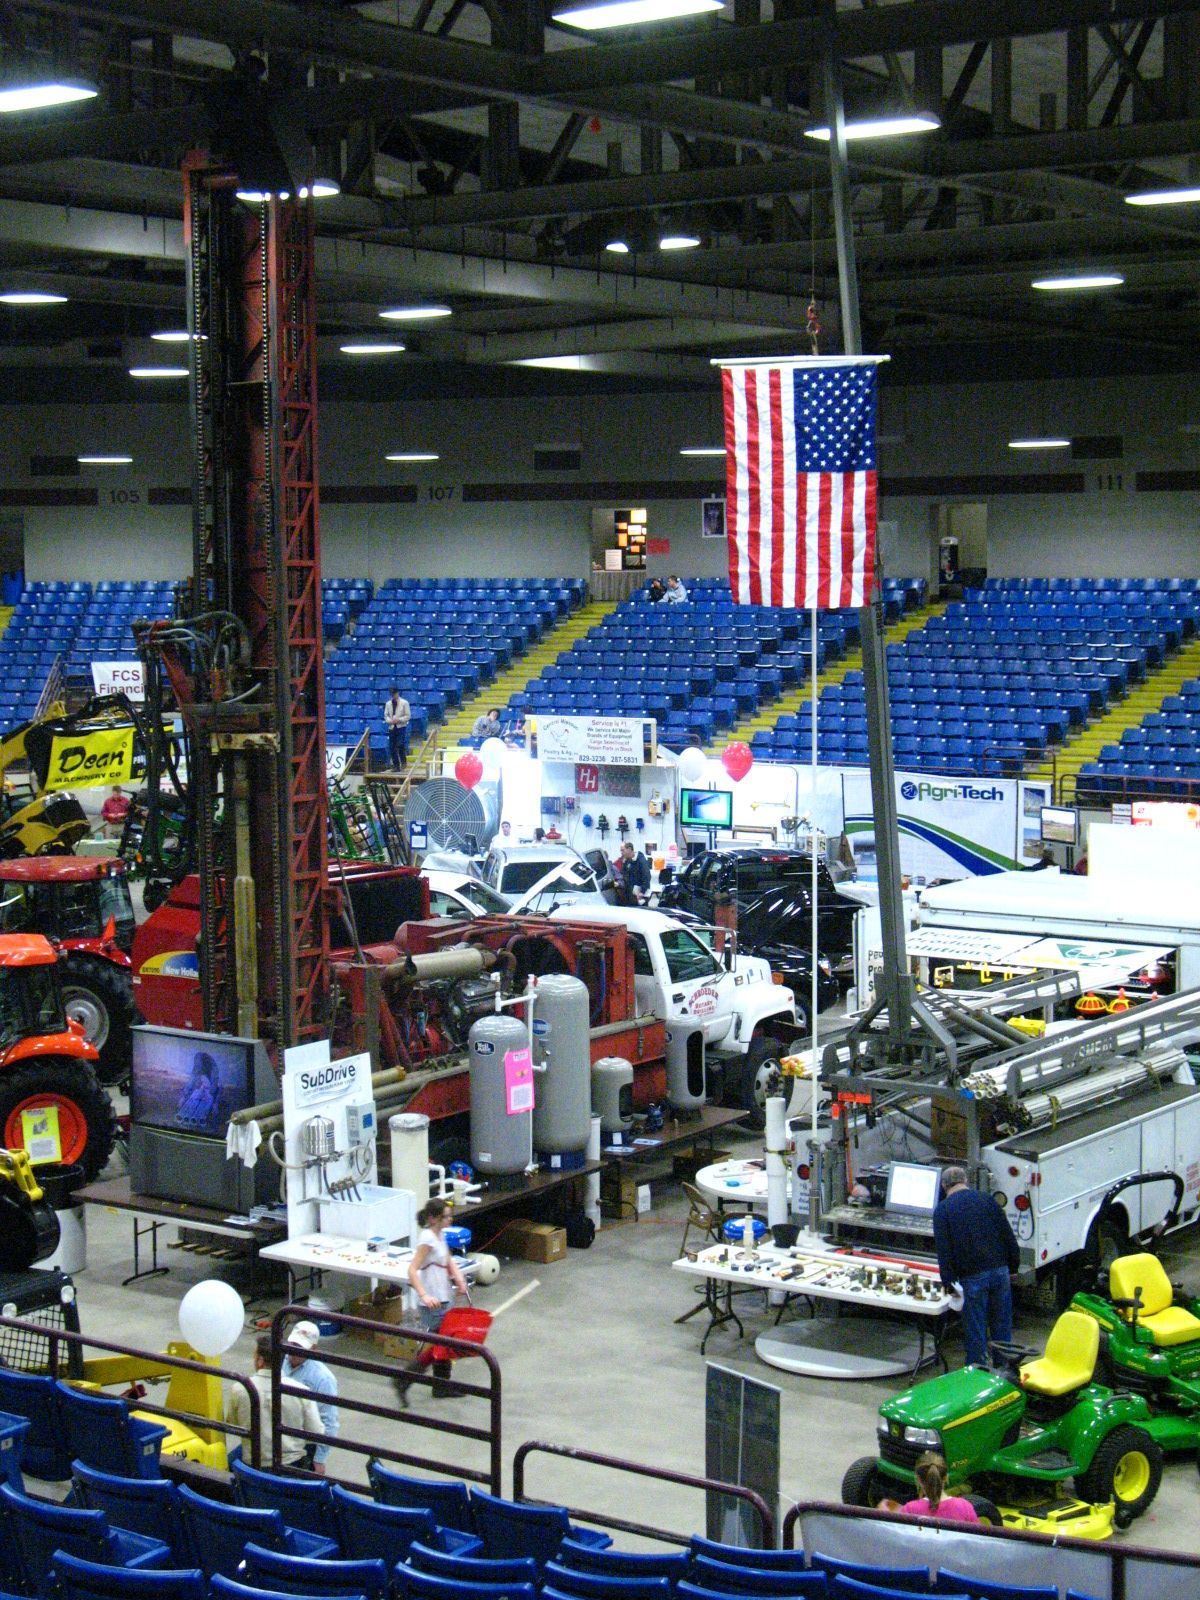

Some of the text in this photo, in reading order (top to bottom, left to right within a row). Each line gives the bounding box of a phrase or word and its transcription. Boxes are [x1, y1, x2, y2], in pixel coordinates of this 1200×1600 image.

[110, 489, 140, 504] 105
[429, 486, 454, 501] 107
[112, 669, 140, 681] FCS
[99, 683, 144, 694] Financi
[591, 719, 613, 727] Service
[58, 745, 125, 773] Dean
[610, 756, 638, 764] 287-5831
[54, 772, 107, 783] MACHINERY
[918, 782, 1004, 801] Agri-Tech
[300, 1064, 356, 1089] SubDrive
